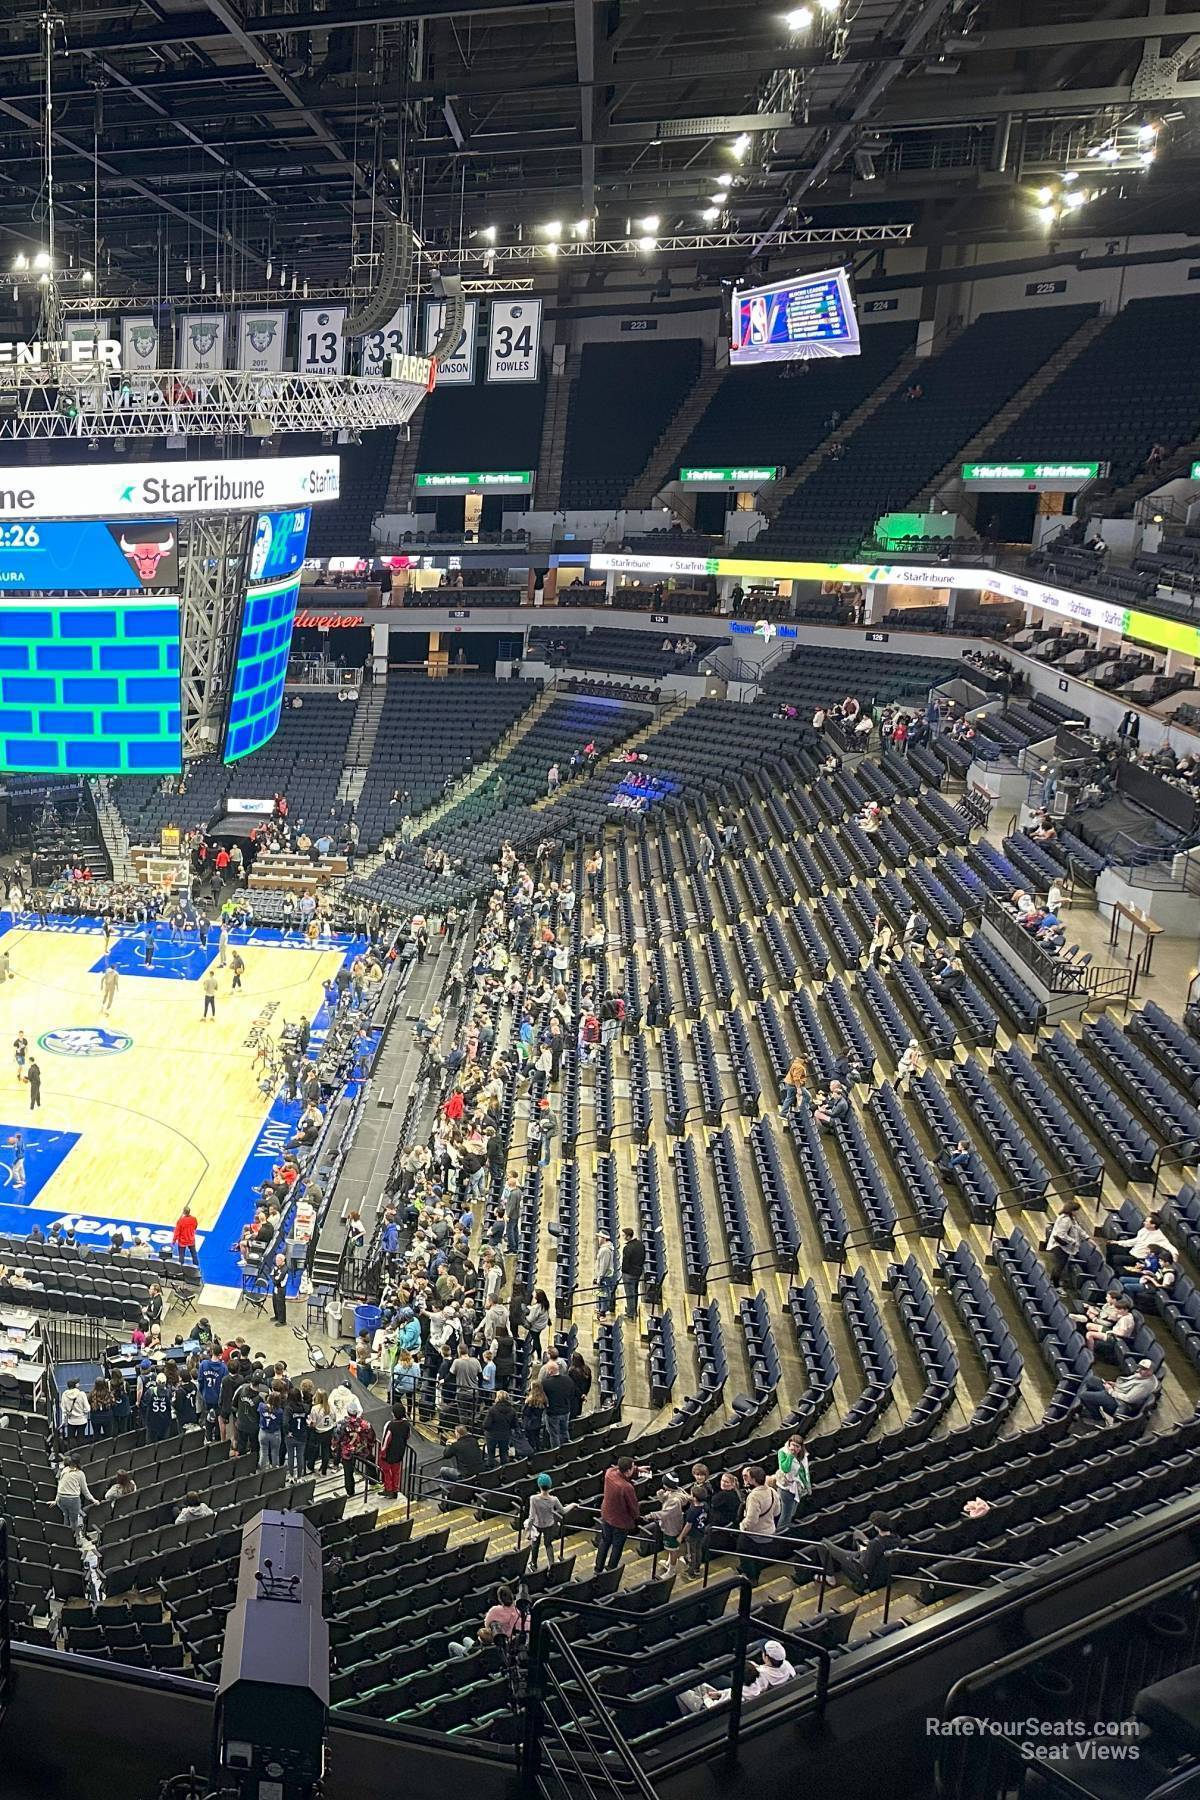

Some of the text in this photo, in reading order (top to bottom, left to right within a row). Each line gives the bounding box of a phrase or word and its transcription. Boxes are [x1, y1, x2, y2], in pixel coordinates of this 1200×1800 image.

[1036, 282, 1055, 294] 225
[306, 332, 338, 365] 13
[368, 329, 403, 364] 33
[494, 325, 533, 359] 34
[435, 362, 469, 374] RUNSON
[496, 361, 530, 372] FOWLES
[142, 475, 265, 505] StarTribune
[902, 571, 955, 583] StarTribune
[292, 610, 364, 628] dweiser
[47, 1213, 205, 1253] etway
[152, 1401, 167, 1413] 55
